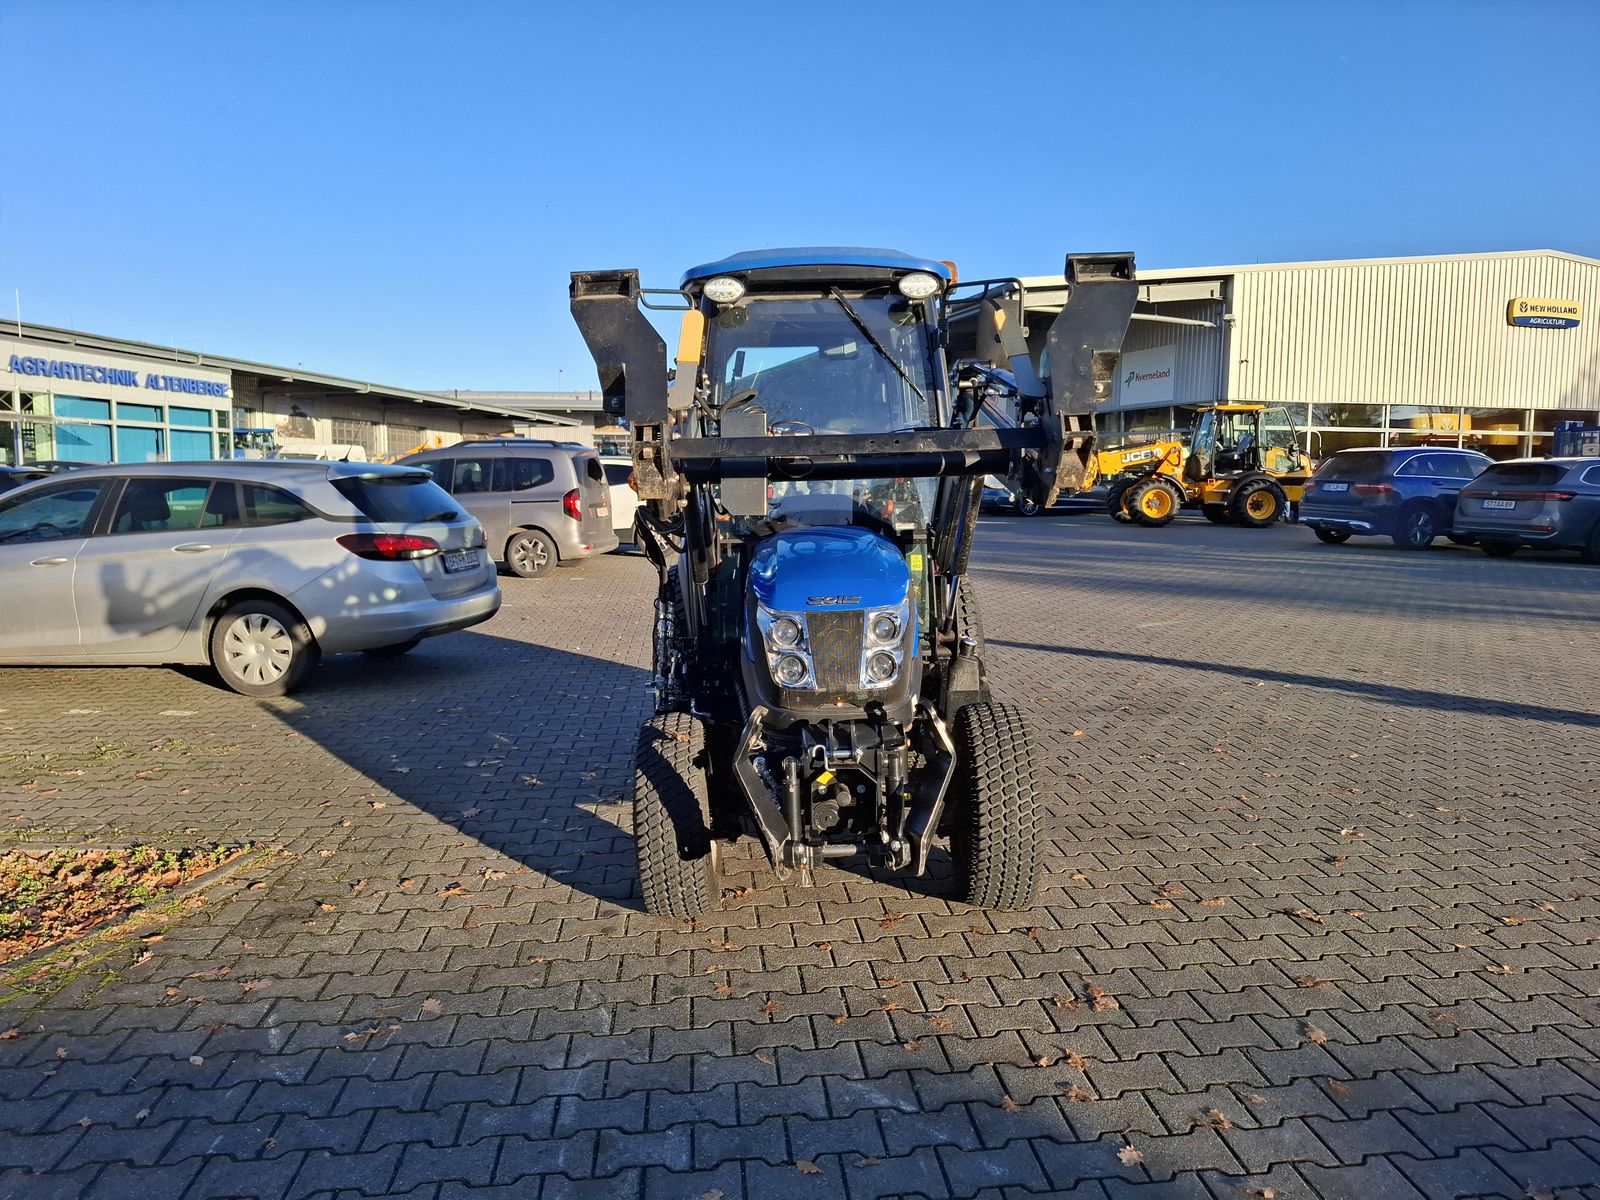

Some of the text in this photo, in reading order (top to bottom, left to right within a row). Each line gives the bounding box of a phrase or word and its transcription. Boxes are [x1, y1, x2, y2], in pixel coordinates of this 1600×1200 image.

[1547, 306, 1577, 314] HOLLAND
[9, 354, 229, 398] AGRARTECHNIK ALTENBERGE
[1135, 368, 1170, 381] Kverneland
[1121, 451, 1153, 463] JCB
